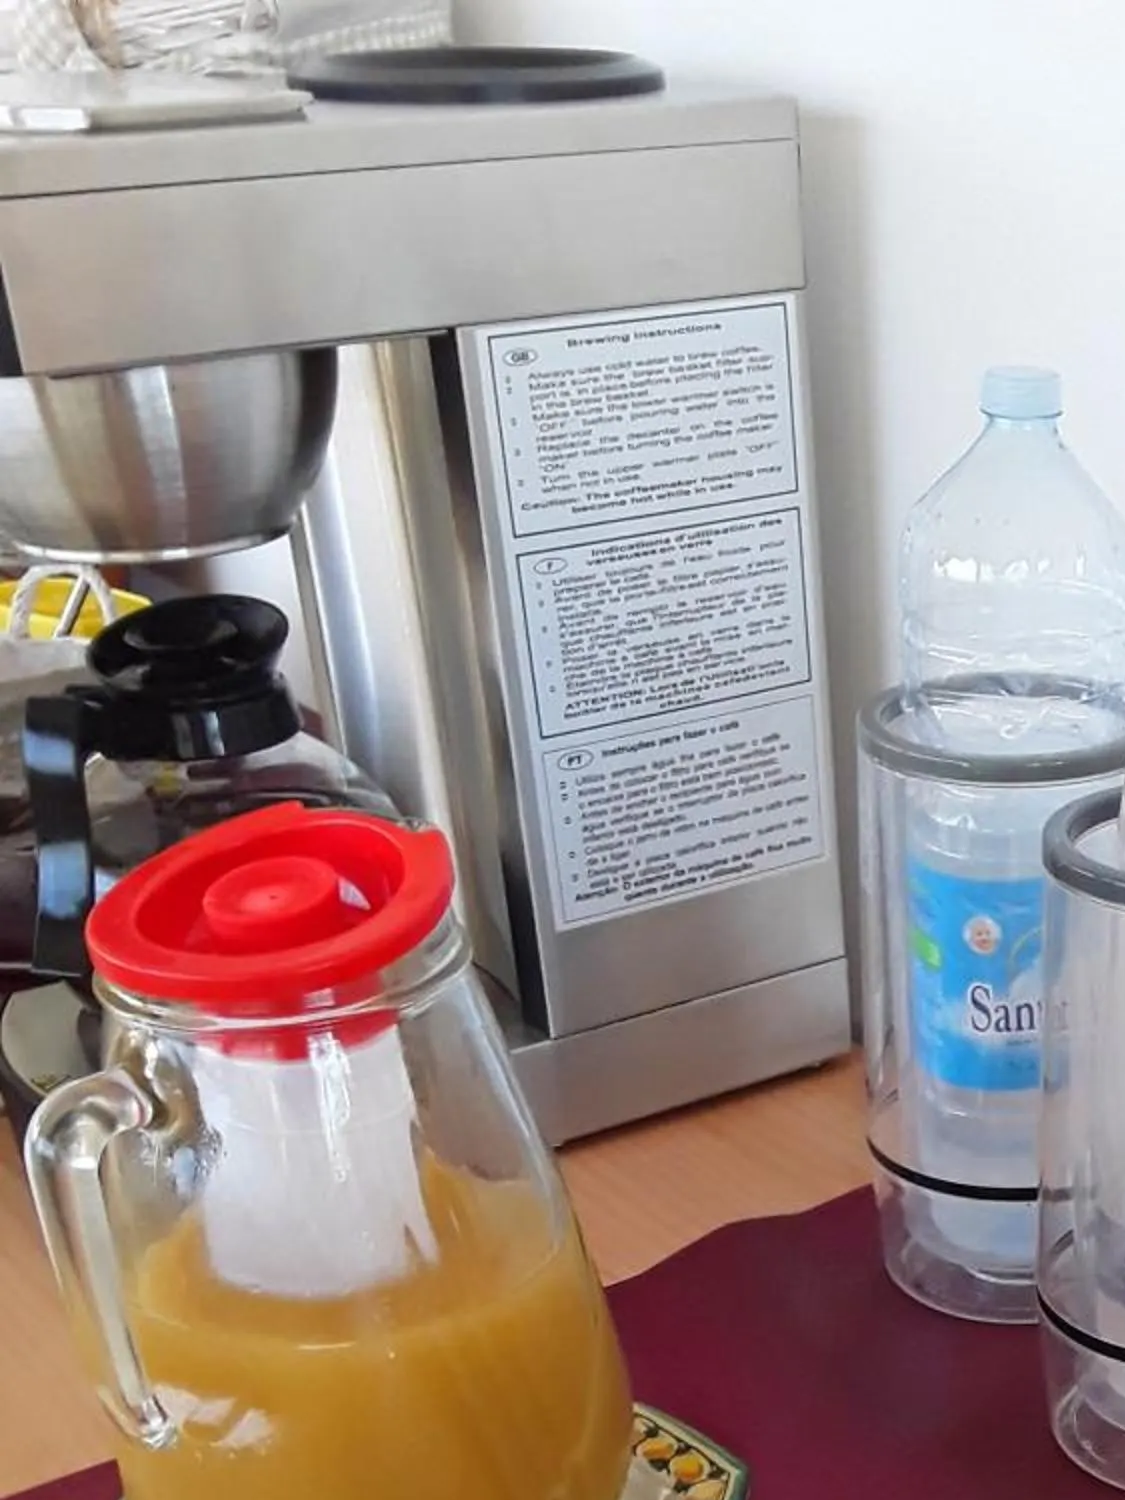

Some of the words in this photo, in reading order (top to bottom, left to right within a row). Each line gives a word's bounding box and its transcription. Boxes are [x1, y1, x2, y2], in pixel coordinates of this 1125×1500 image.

[566, 332, 630, 349] Brewing
[527, 367, 575, 382] Always
[577, 363, 602, 376] use
[634, 355, 669, 368] water
[722, 366, 743, 378] the
[528, 378, 566, 392] Make
[569, 374, 600, 386] sure
[602, 371, 625, 382] the
[531, 409, 570, 423] Make
[573, 404, 603, 417] sure
[606, 401, 628, 413] the
[598, 433, 619, 445] the
[713, 417, 733, 429] the
[673, 433, 693, 445] the
[577, 467, 599, 479] the
